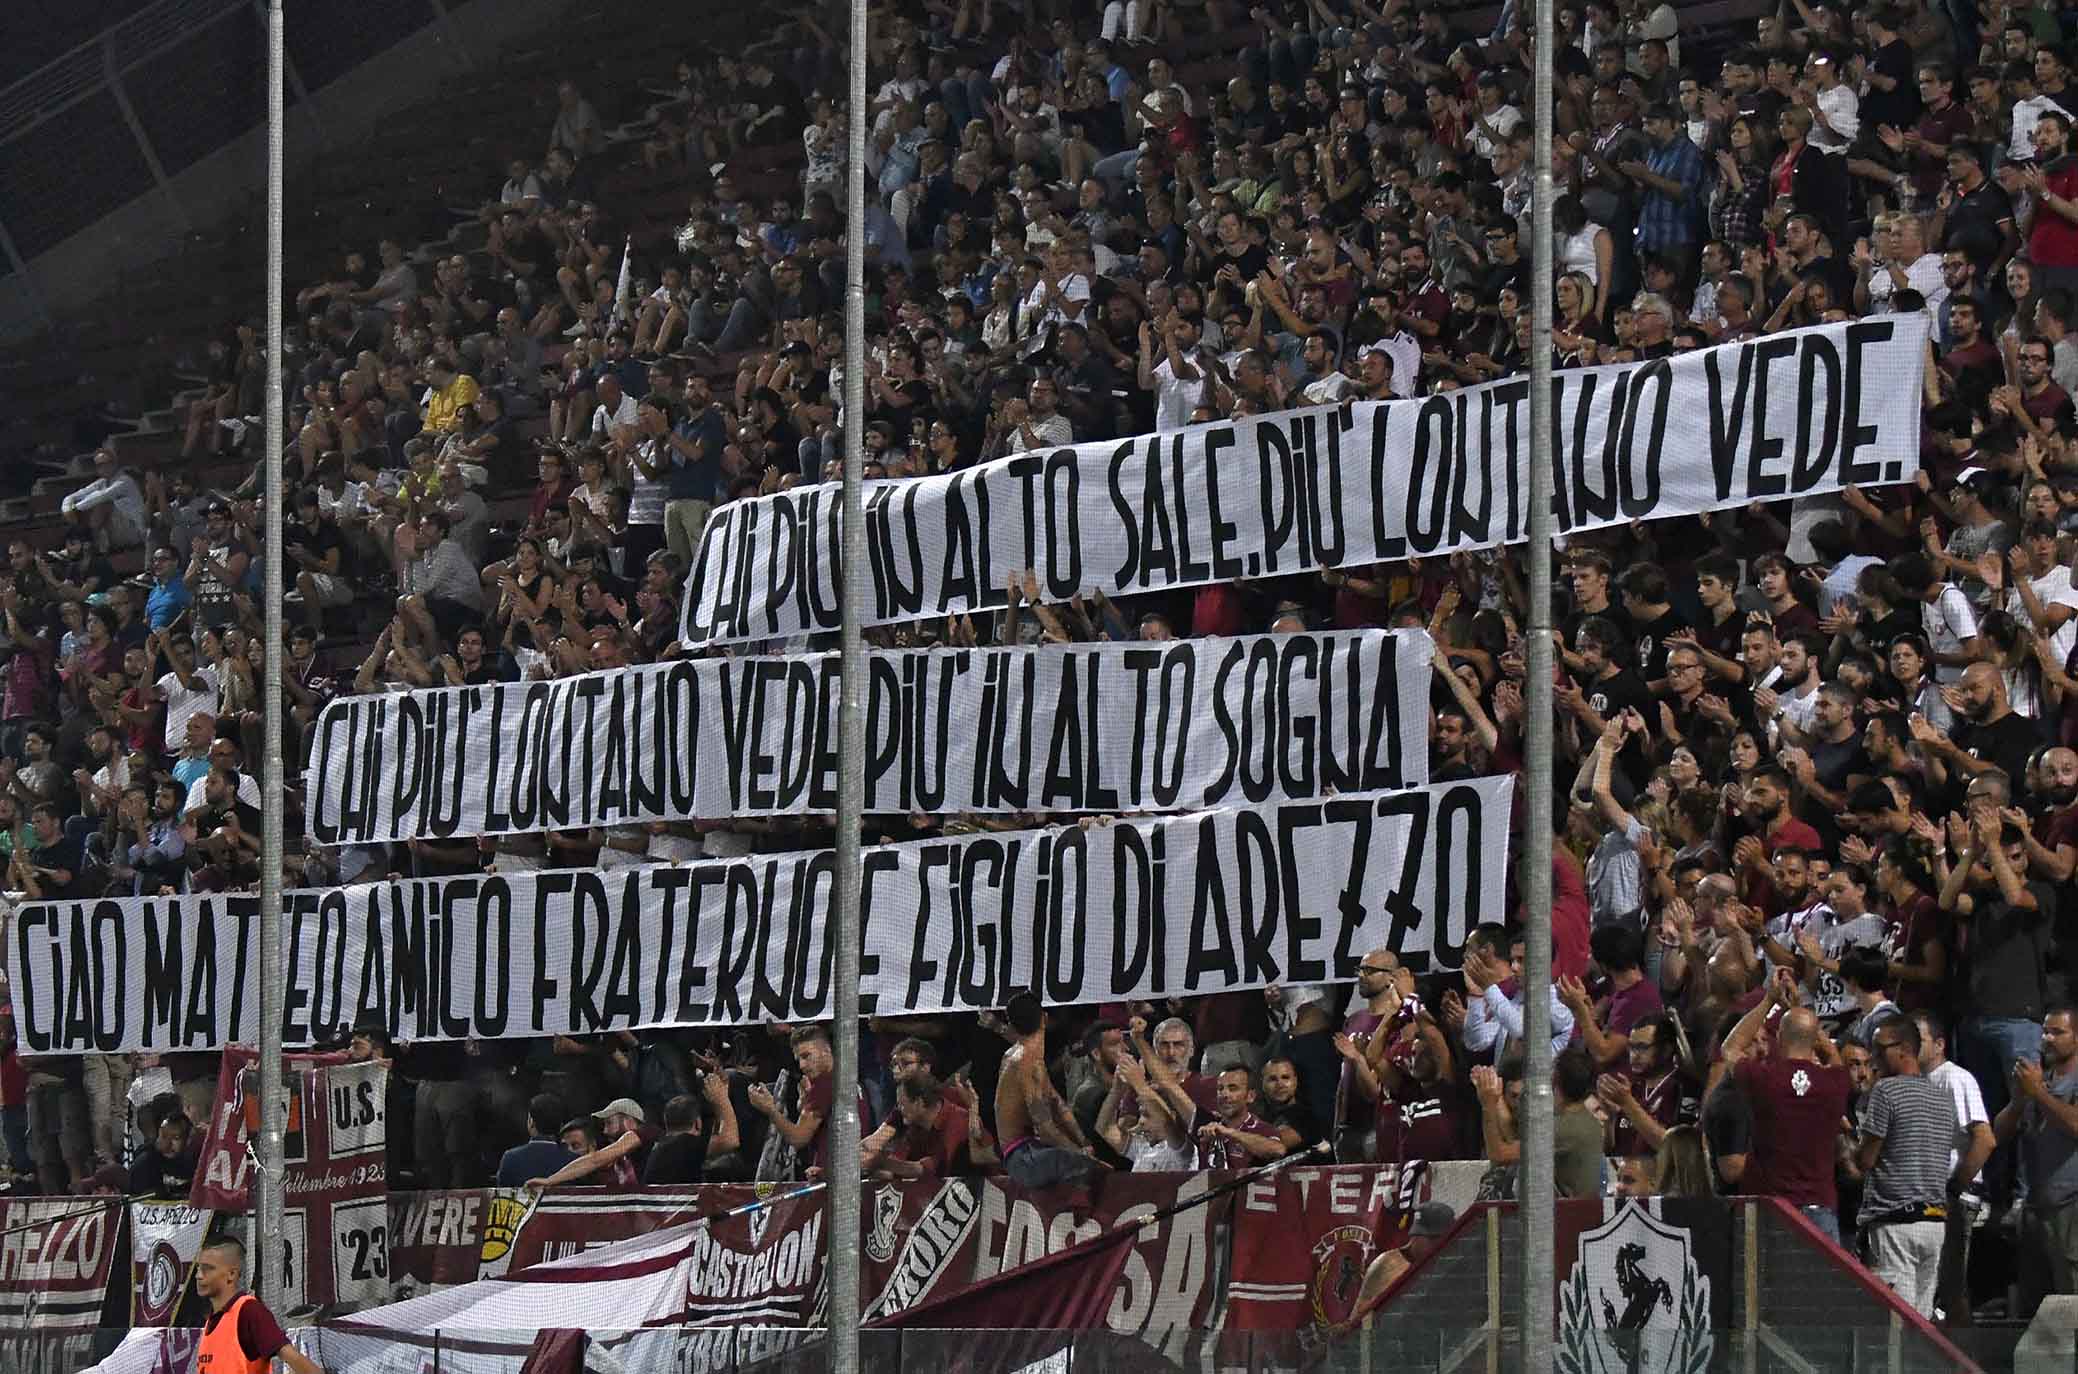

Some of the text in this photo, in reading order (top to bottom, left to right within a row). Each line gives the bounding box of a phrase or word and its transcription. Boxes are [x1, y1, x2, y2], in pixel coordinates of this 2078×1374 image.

[937, 450, 1081, 613] ALTO
[1705, 321, 1902, 501] VEDE.
[485, 664, 699, 829] LONTANO
[720, 658, 842, 811] VEDE
[1043, 643, 1195, 808] ALTO
[531, 851, 836, 1033] FRATERNO
[858, 850, 900, 1016] E
[1185, 785, 1482, 991] AREZZO
[334, 1080, 383, 1131] U.S.
[139, 1207, 160, 1225] U.S.
